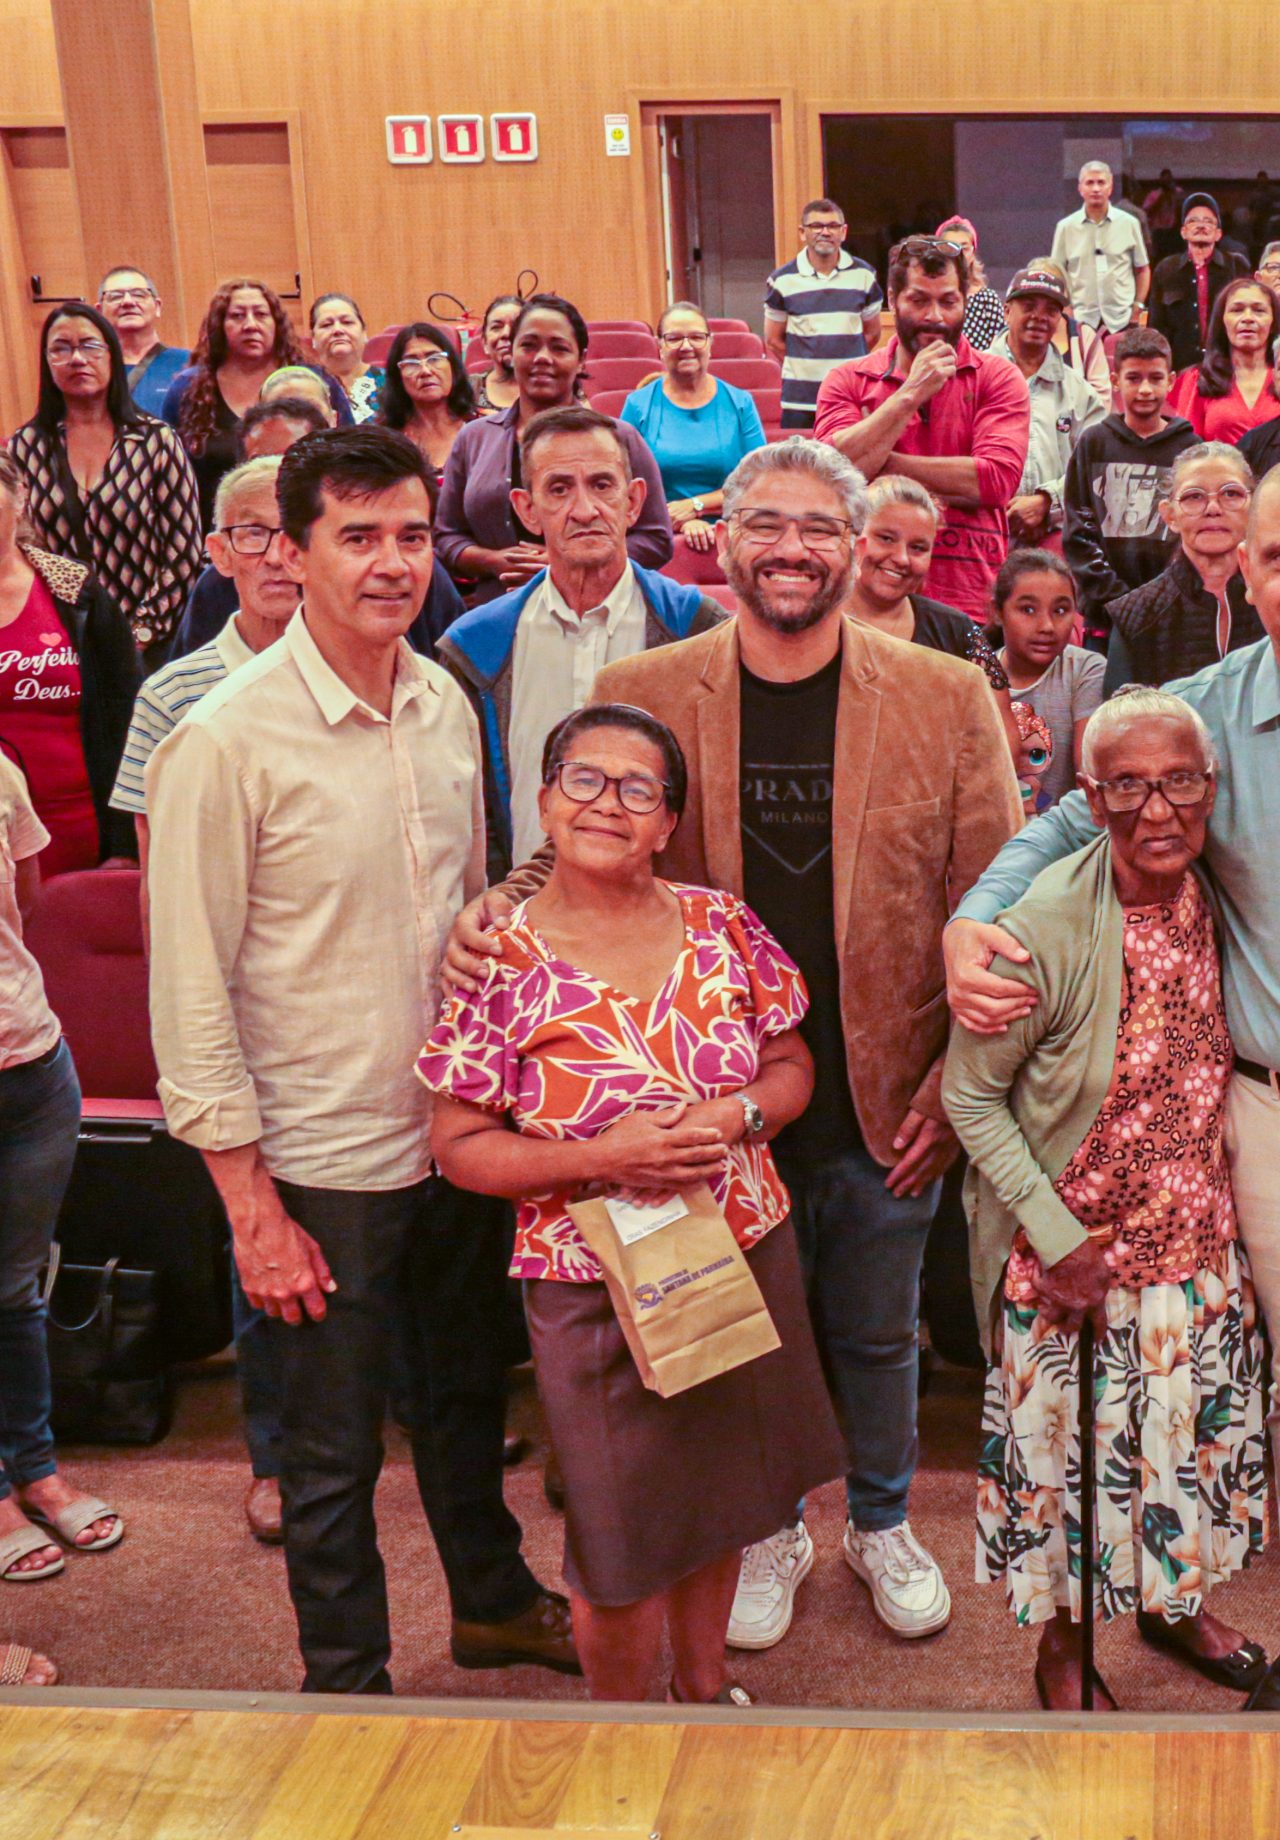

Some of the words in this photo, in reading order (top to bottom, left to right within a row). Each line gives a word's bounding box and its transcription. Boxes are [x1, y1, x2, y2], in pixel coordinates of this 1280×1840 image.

[760, 811, 828, 823] MILANO
[662, 1274, 692, 1295] SANTANA
[691, 1271, 701, 1280] DE
